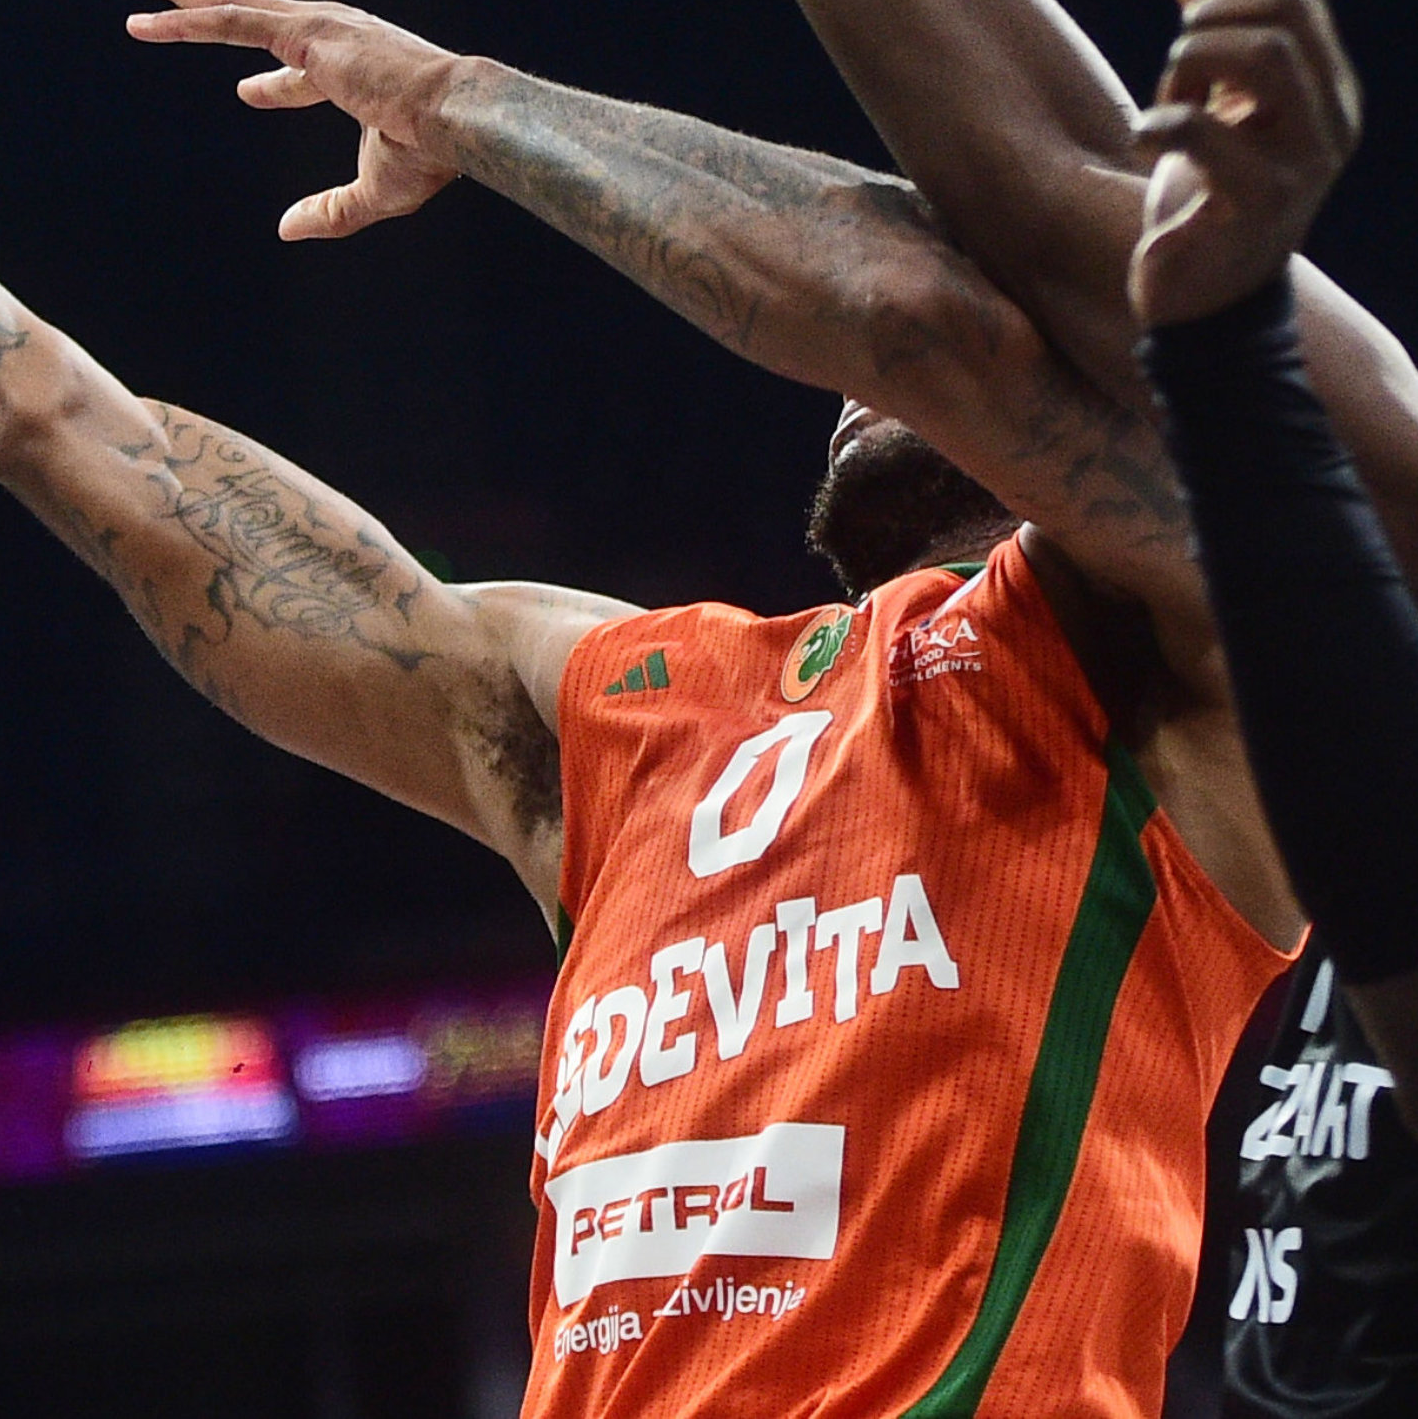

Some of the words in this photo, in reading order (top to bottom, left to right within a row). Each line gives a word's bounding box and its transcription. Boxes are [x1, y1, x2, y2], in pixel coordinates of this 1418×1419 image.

[914, 648, 945, 671] FOOD
[687, 709, 835, 879] 0
[570, 1166, 795, 1257] PETROL
